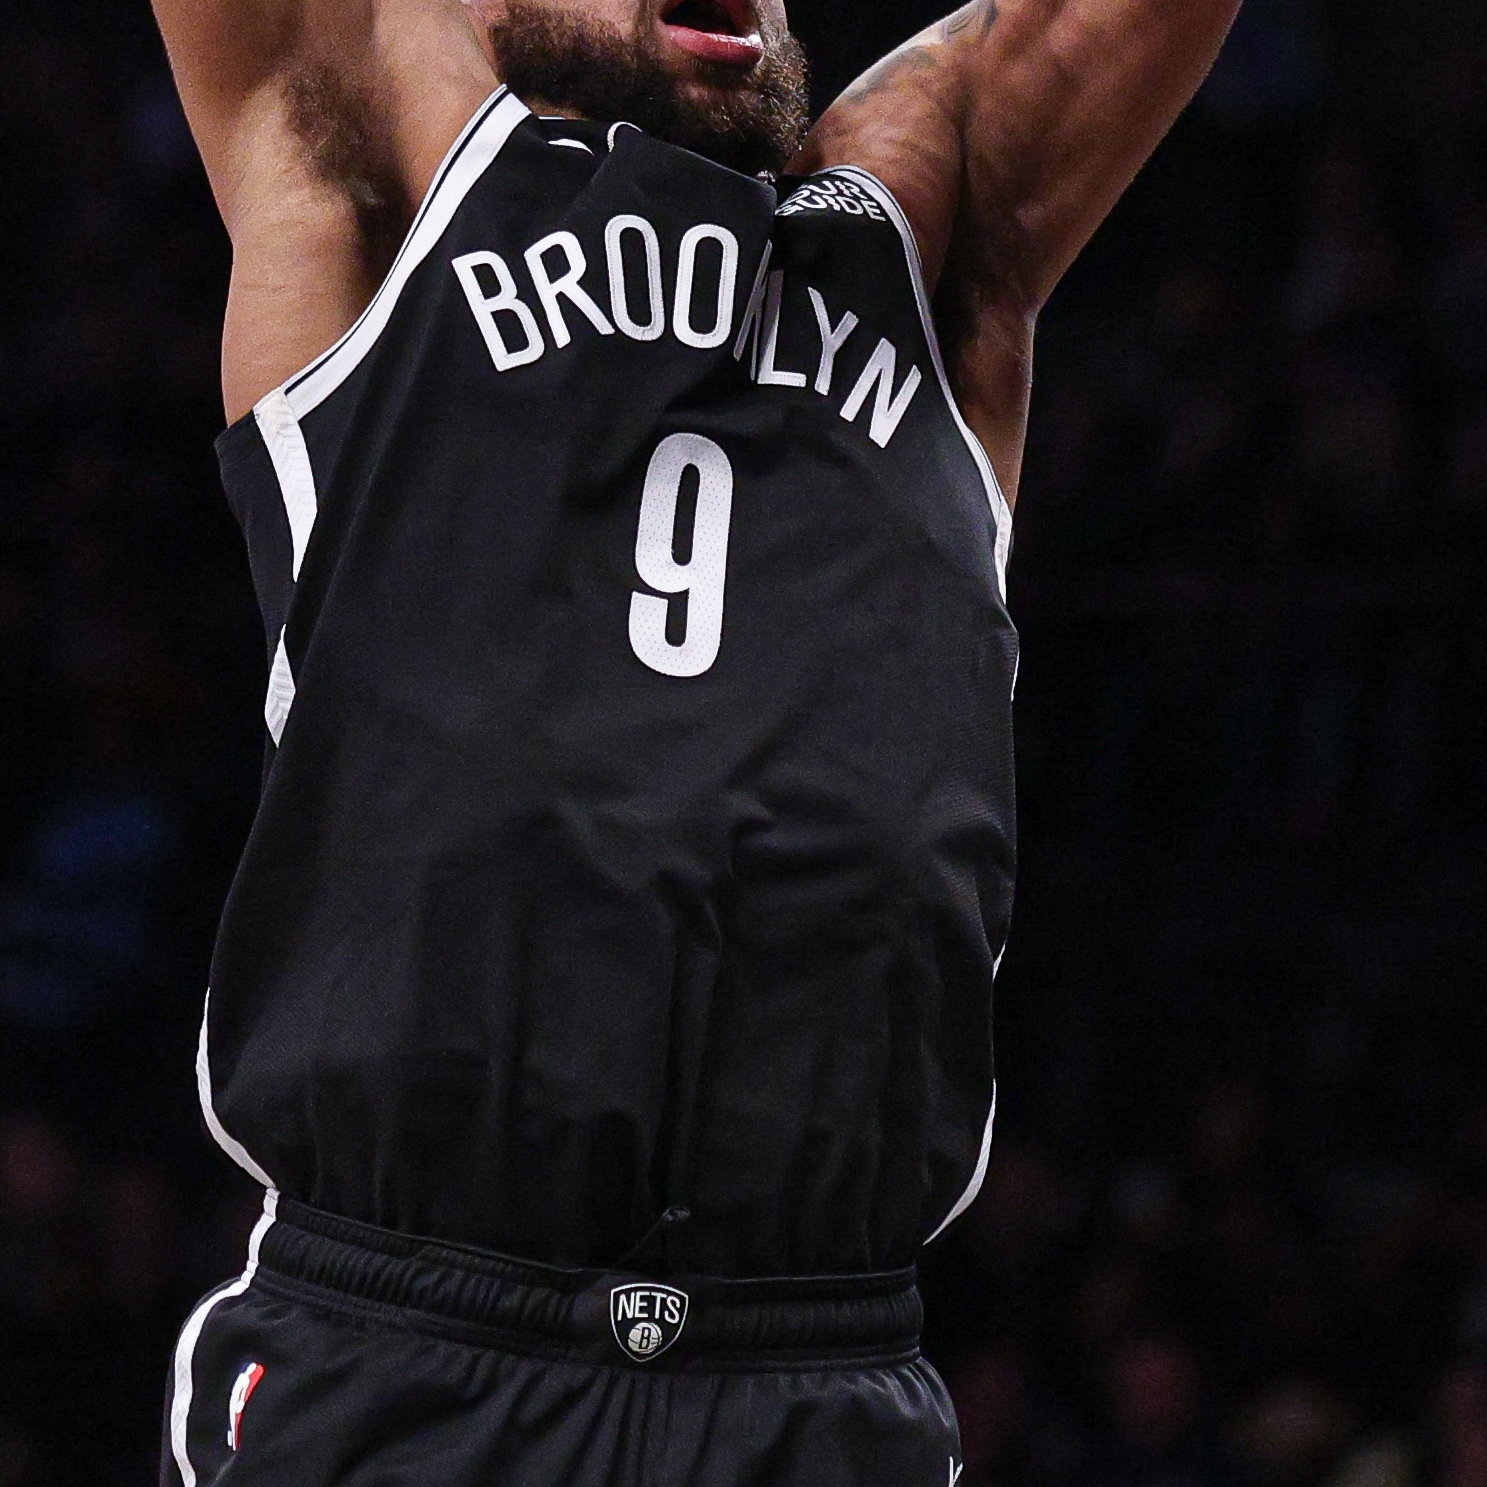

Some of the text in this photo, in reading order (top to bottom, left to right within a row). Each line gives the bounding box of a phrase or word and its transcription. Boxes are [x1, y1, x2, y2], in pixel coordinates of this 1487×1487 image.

[451, 214, 922, 449] BROOKLYN
[628, 431, 734, 678] 9
[617, 1291, 681, 1324] NETS
[638, 1326, 652, 1350] B
